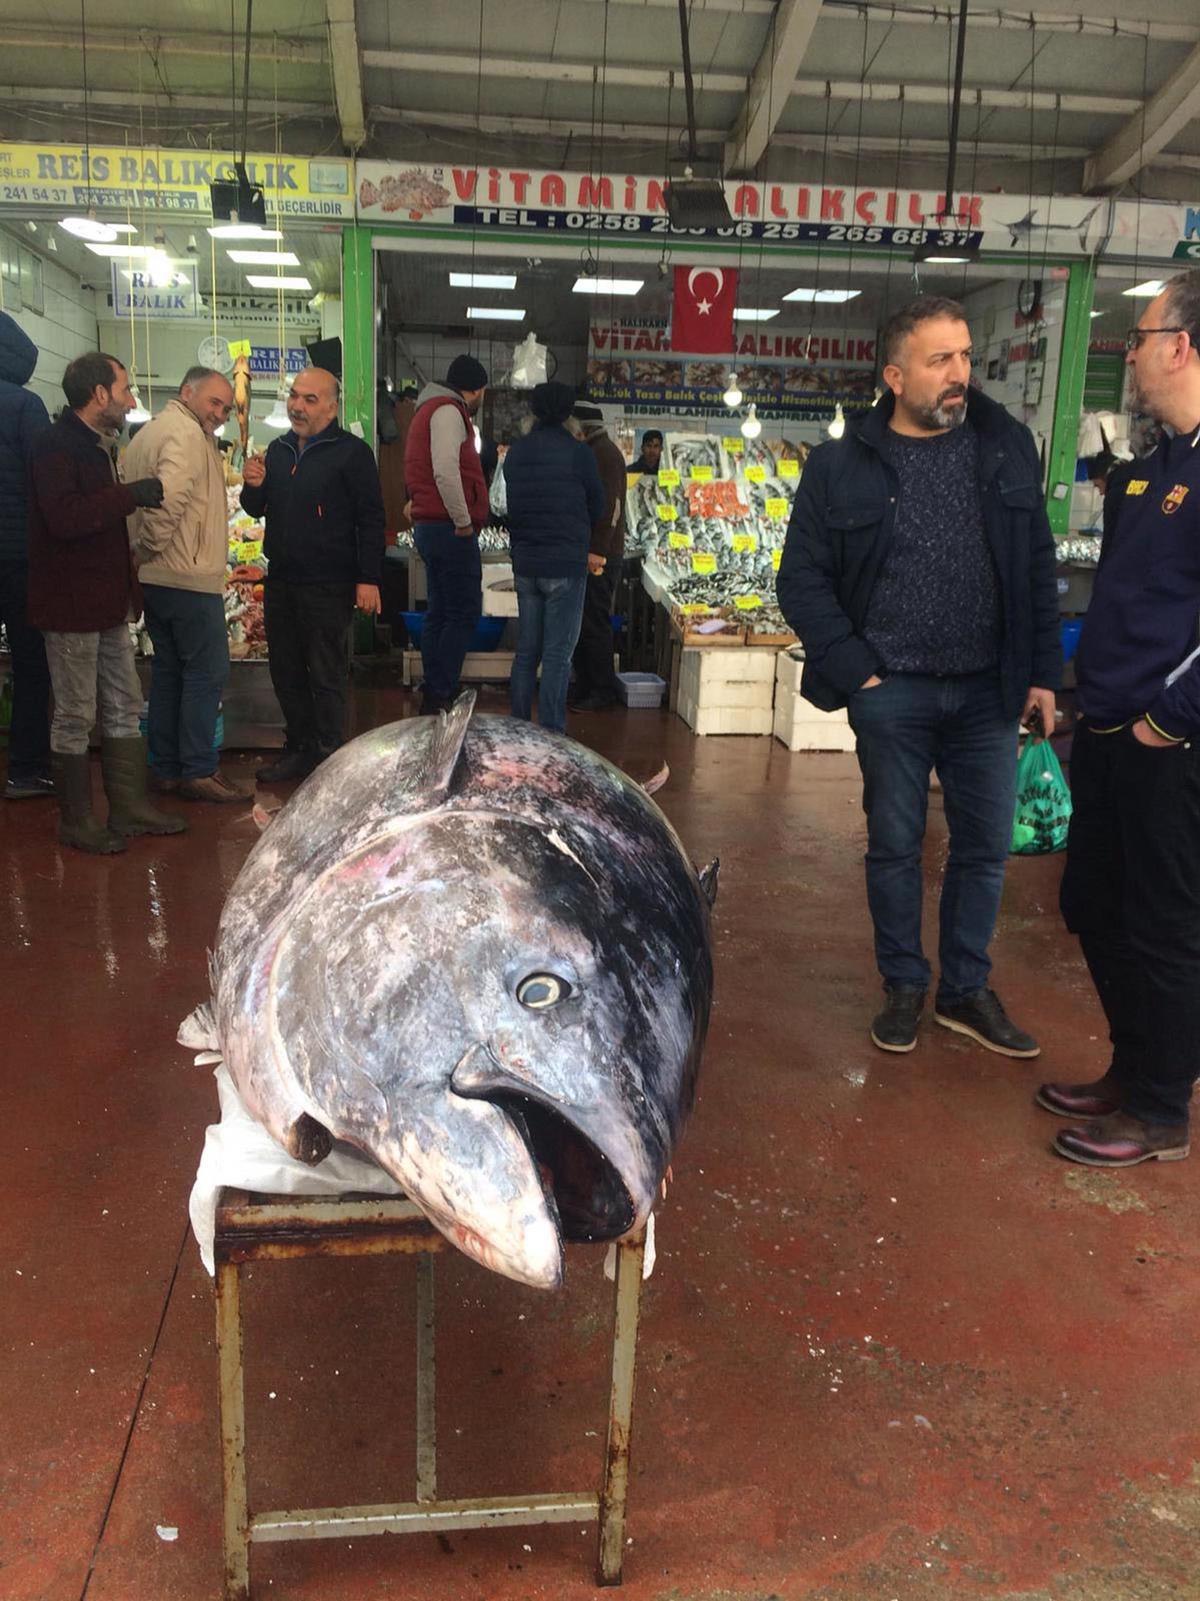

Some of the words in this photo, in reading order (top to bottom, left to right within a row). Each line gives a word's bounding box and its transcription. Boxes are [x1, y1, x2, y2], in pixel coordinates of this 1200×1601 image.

[37, 149, 110, 181] REİS
[120, 156, 298, 190] BALIKÇLIK
[4, 187, 28, 200] 241
[32, 188, 49, 200] 54
[52, 189, 67, 201] 37
[183, 198, 196, 209] 37
[278, 199, 342, 215] GEÇERLİDİR
[734, 185, 984, 227] ALIKÇILIK
[477, 208, 537, 227] TEL
[566, 213, 641, 231] 0258
[762, 223, 800, 239] 25
[827, 226, 884, 244] 265
[892, 229, 928, 246] 68
[937, 230, 974, 246] 37
[126, 293, 186, 308] BALIK
[733, 334, 876, 364] ALIKÇILIK
